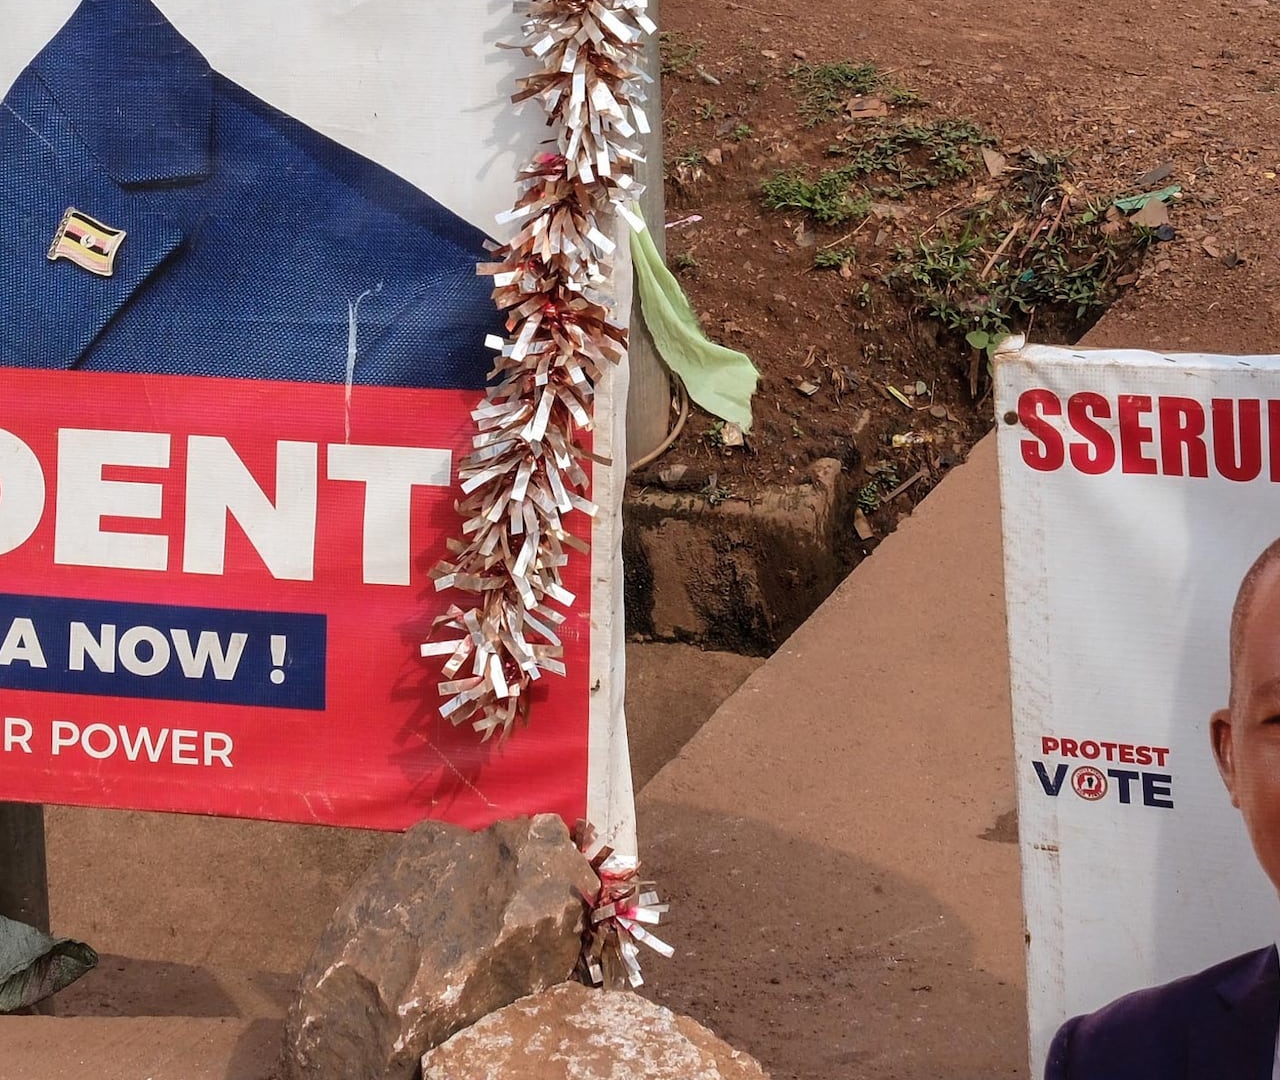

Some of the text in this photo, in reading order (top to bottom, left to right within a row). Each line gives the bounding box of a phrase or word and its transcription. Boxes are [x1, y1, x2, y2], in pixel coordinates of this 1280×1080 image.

[68, 622, 248, 681] NOW
[267, 633, 287, 685] !
[50, 719, 235, 768] POWER
[1041, 736, 1170, 767] PROTEST
[1032, 761, 1174, 809] VOTE
